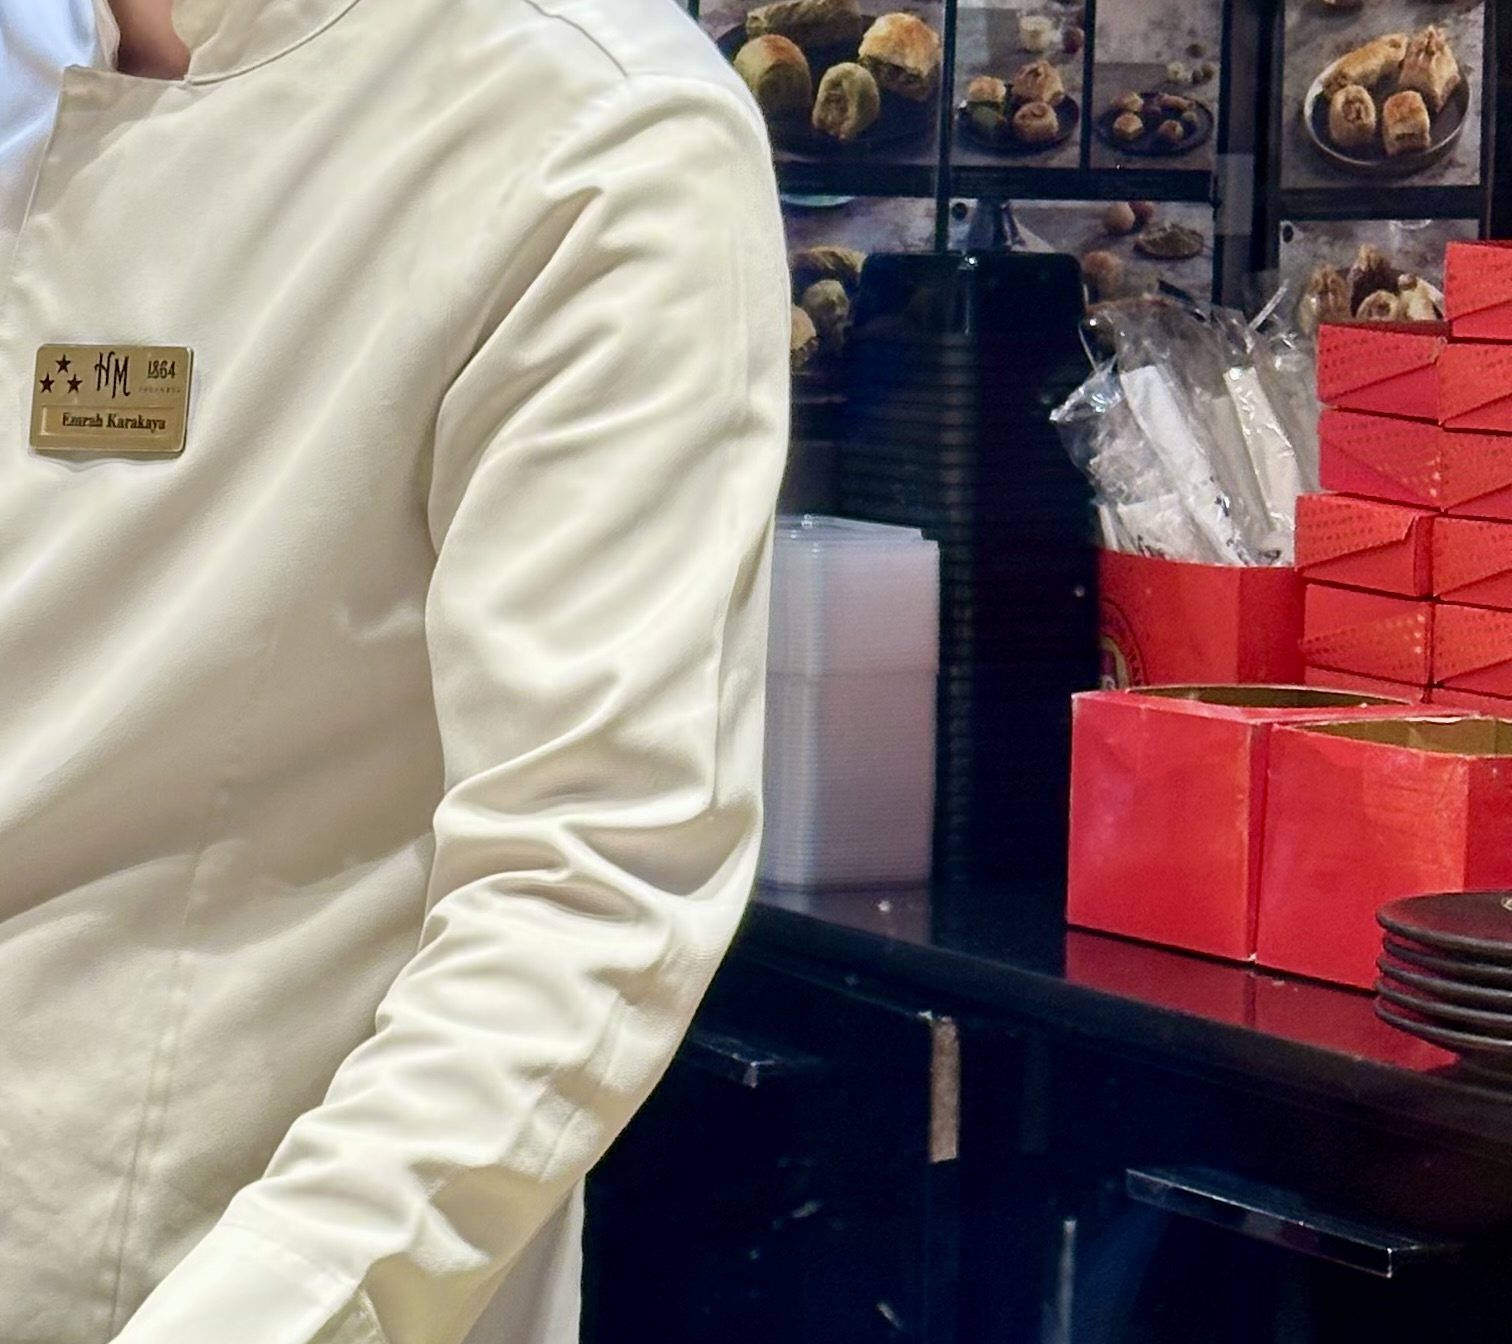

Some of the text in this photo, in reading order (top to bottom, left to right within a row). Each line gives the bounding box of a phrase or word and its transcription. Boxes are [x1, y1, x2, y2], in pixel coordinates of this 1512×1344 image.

[94, 351, 176, 399] HM 1864
[62, 411, 166, 434] Emrah Karakaya
